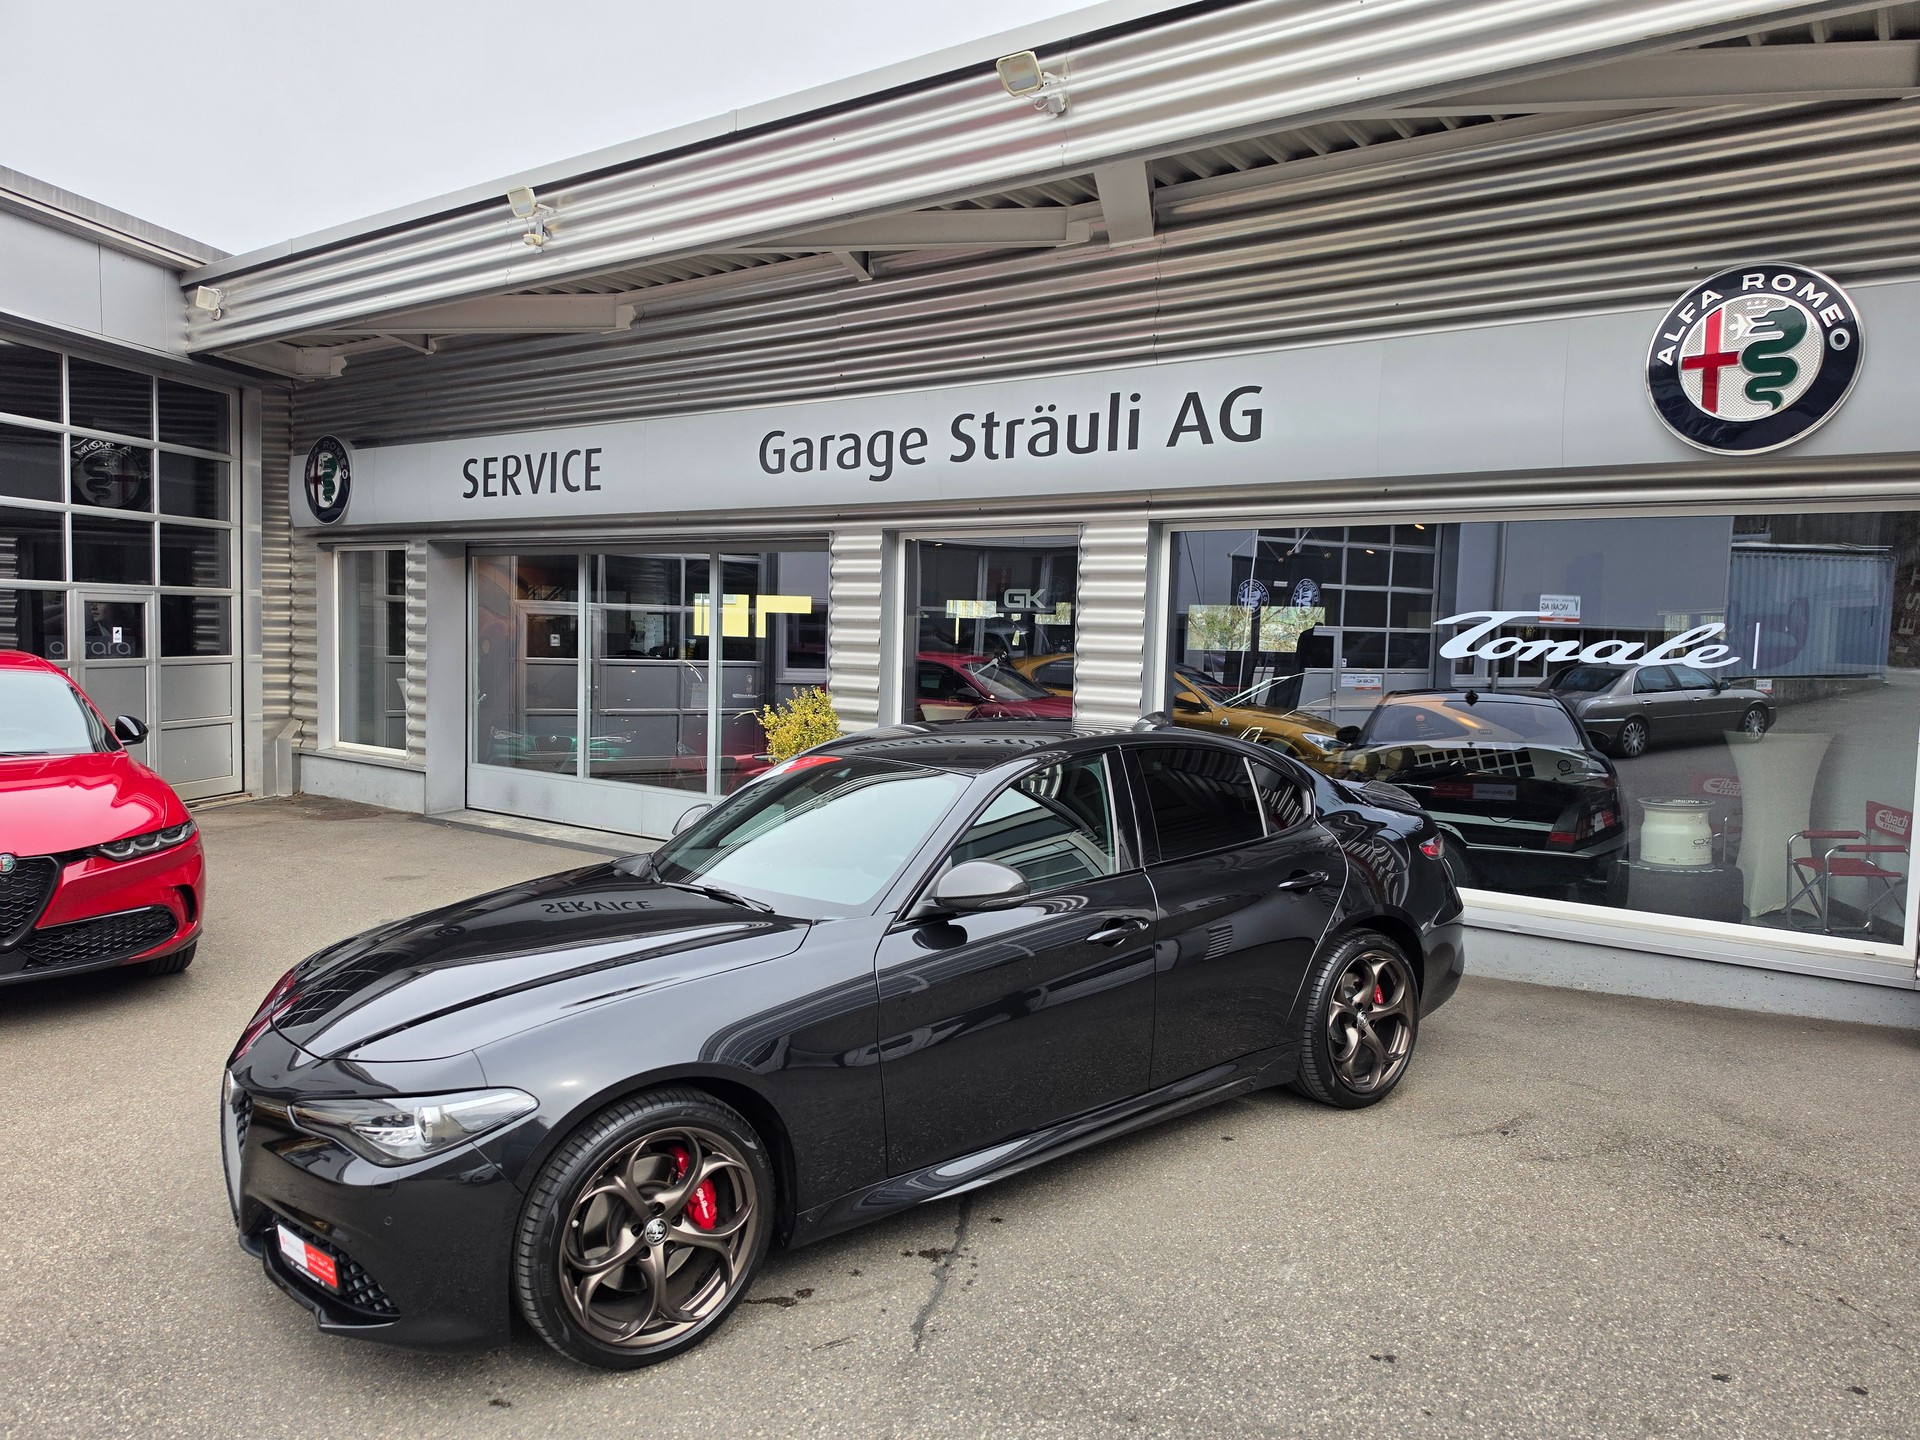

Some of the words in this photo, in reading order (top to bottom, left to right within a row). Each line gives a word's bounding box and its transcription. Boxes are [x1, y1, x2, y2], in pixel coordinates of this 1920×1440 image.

[1657, 289, 1723, 366] ALFA
[1742, 273, 1850, 350] ROMEO
[759, 427, 928, 482] Garage
[950, 392, 1141, 462] Sträuli
[1166, 385, 1263, 447] AG
[323, 441, 348, 479] ROMEO
[463, 448, 602, 499] SERVICE
[1004, 589, 1046, 608] GK
[49, 641, 132, 655] aara
[1433, 611, 1741, 669] Tonale
[1703, 778, 1741, 795] Eiba
[1875, 810, 1909, 834] Eibach
